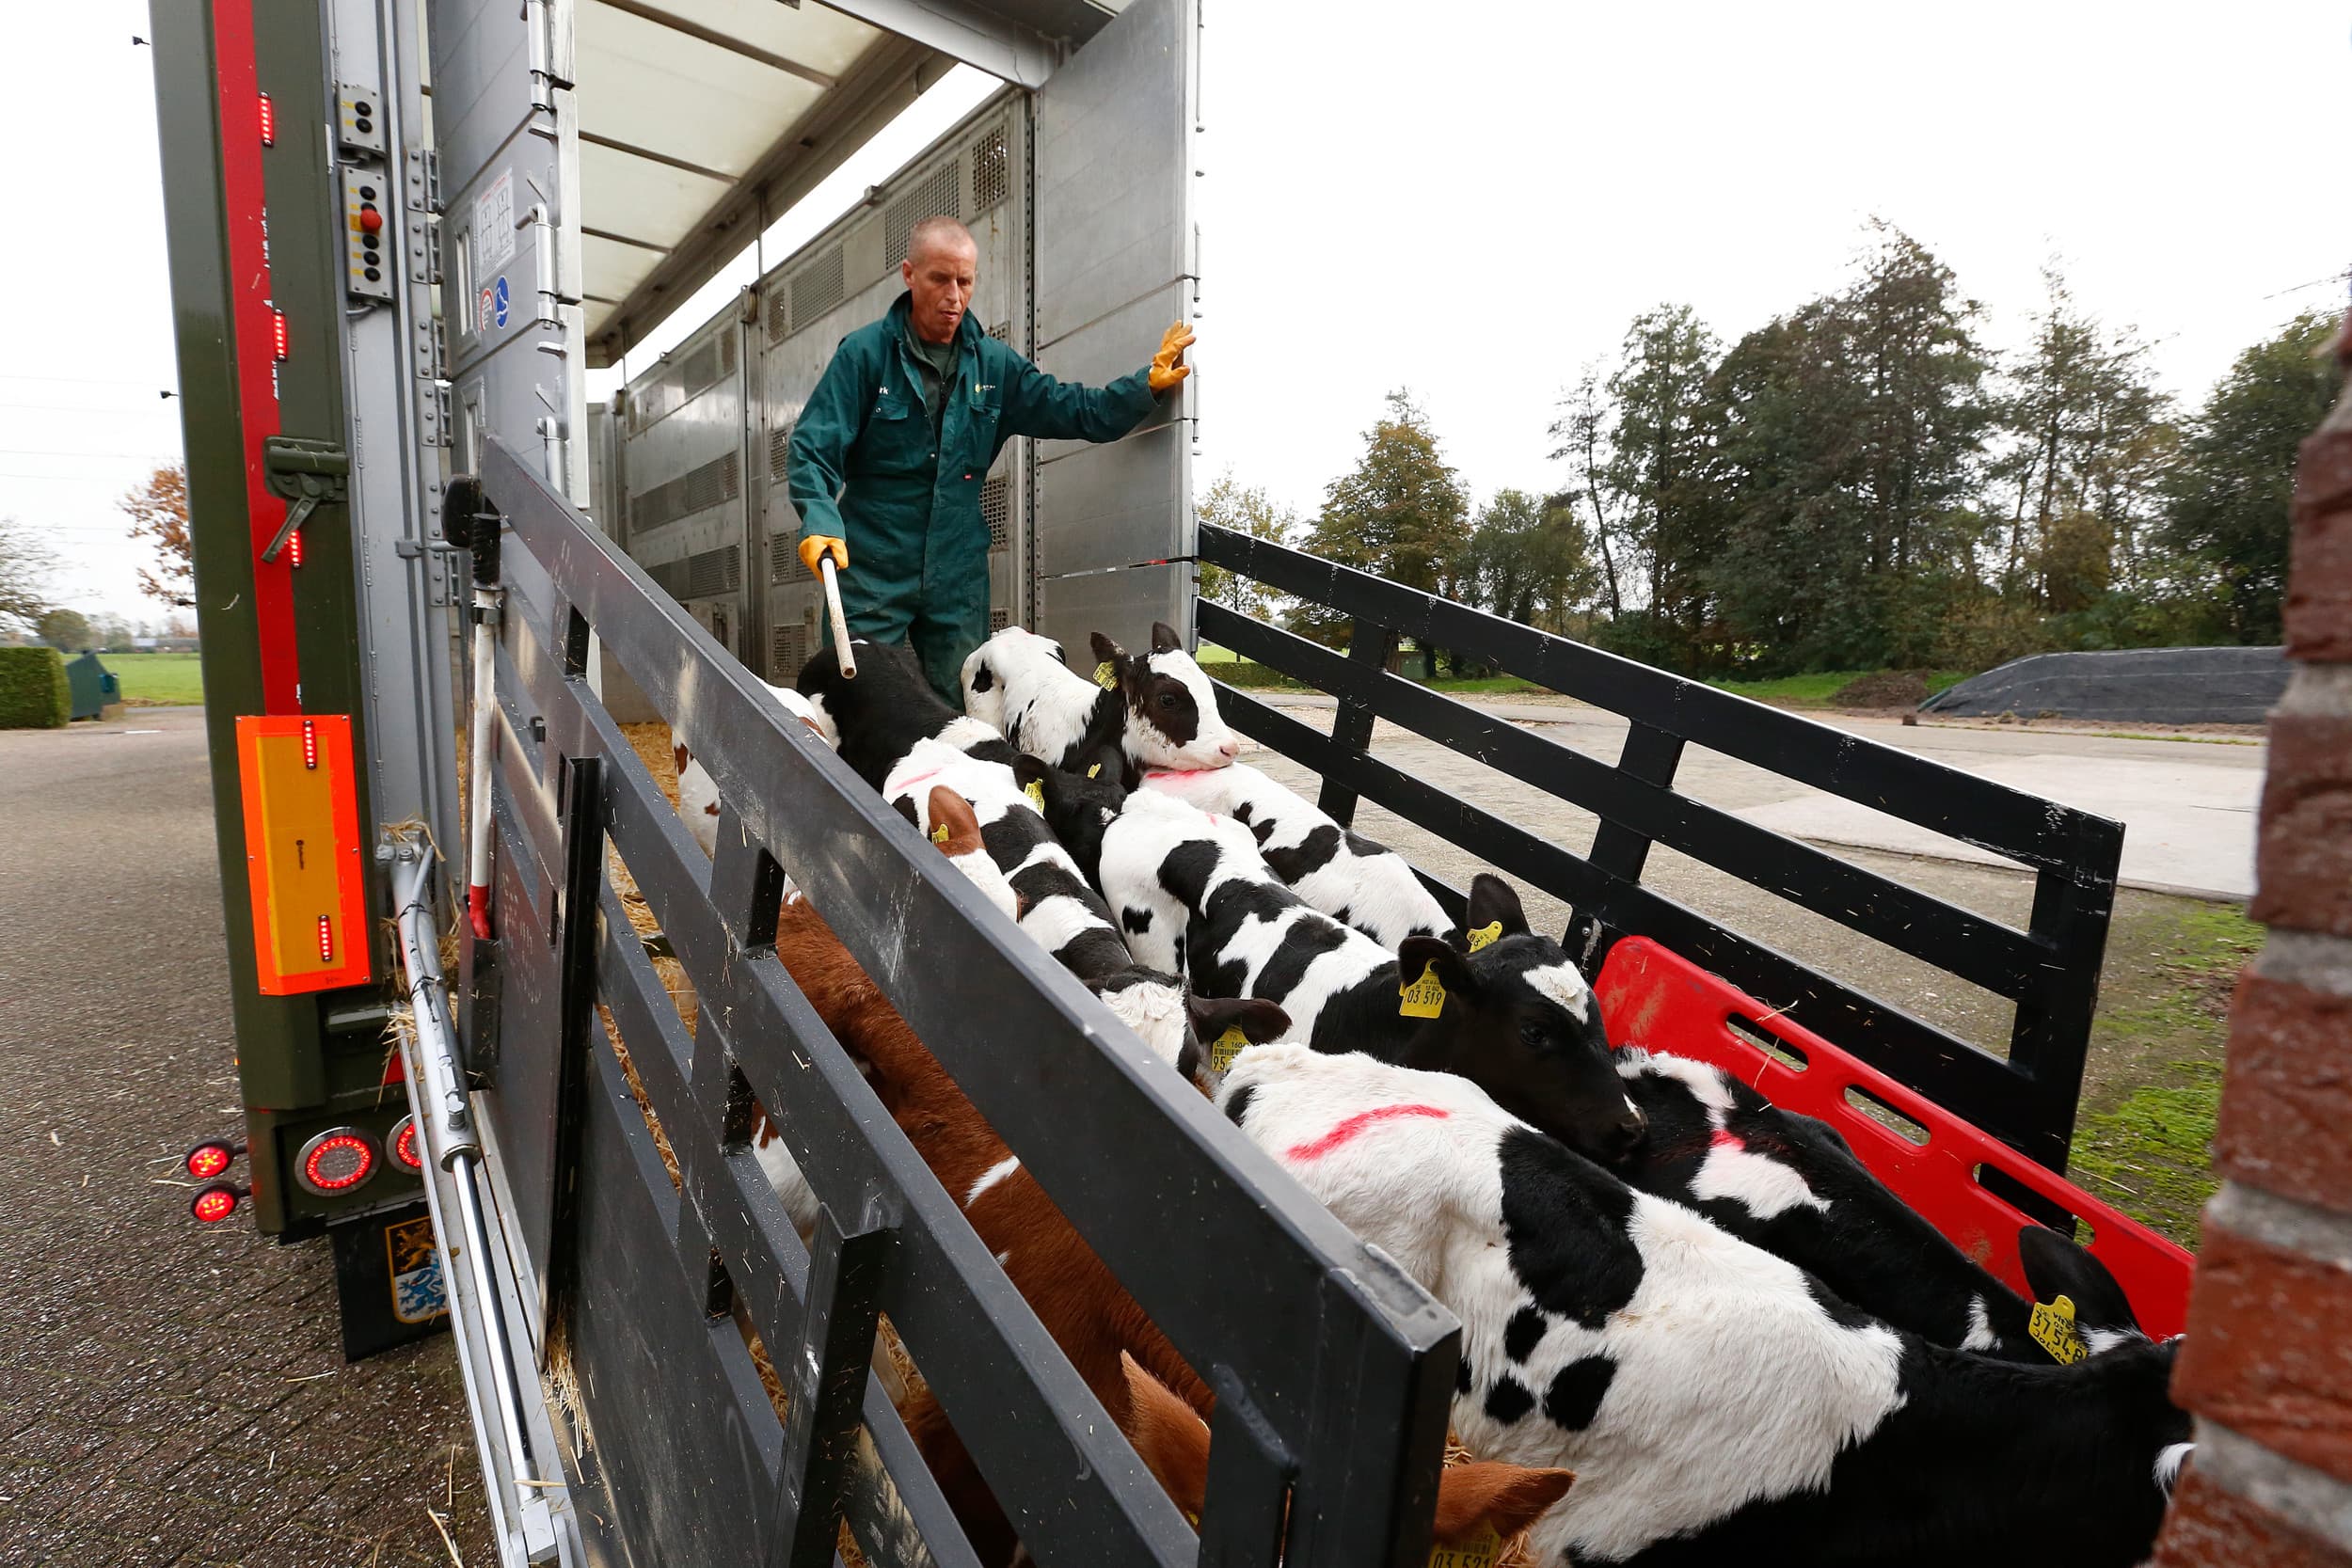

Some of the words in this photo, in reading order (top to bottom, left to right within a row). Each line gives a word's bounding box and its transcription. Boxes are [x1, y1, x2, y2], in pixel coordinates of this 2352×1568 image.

[1407, 990, 1420, 1004] 03
[1423, 990, 1442, 1006] 519
[1214, 1055, 1226, 1070] 95
[2033, 1309, 2051, 1335] 37
[2053, 1329, 2083, 1362] 548
